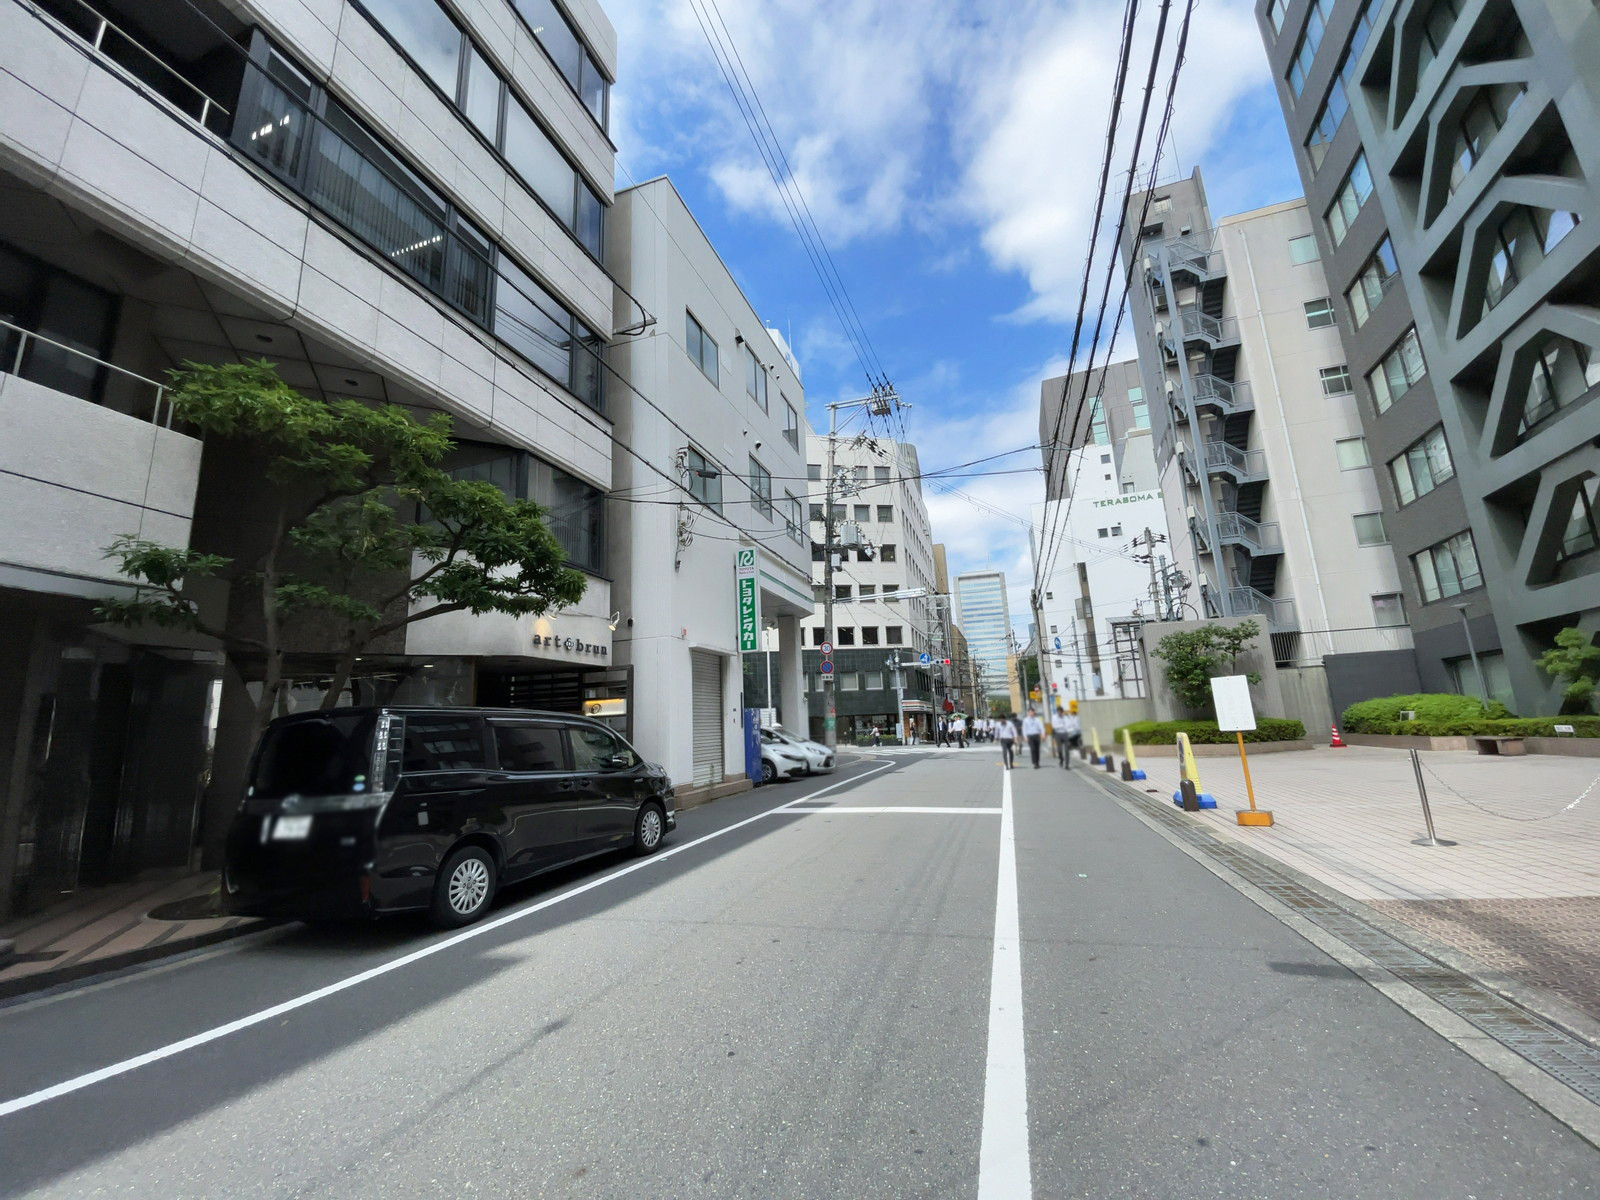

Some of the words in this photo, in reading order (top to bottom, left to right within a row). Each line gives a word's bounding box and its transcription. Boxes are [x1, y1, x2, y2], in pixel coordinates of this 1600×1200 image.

[742, 579, 754, 649] トヨタレンタカー
[533, 634, 561, 648] art
[575, 638, 608, 656] brun
